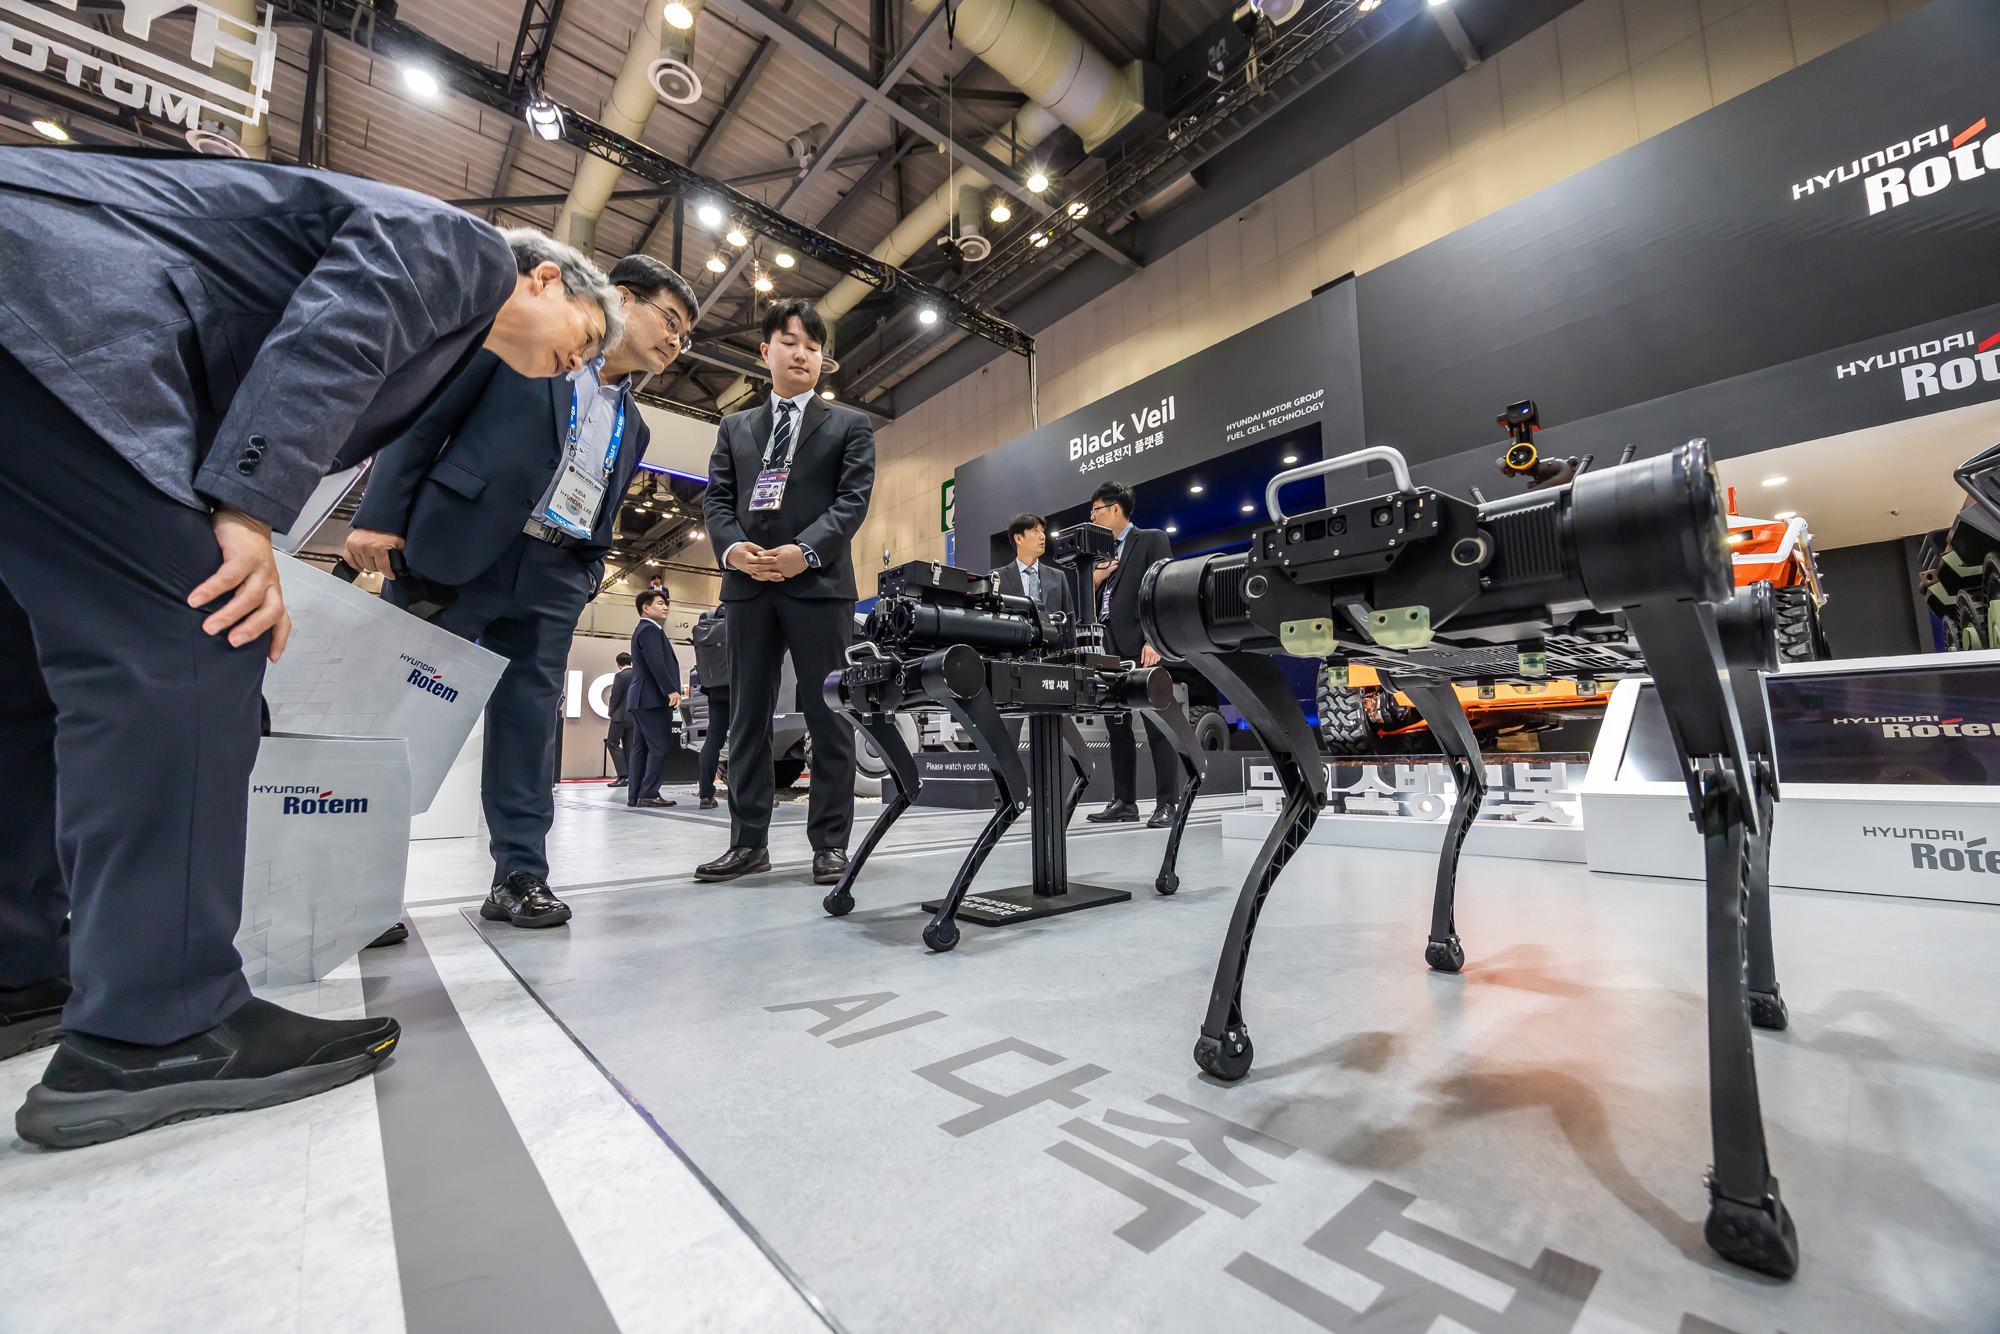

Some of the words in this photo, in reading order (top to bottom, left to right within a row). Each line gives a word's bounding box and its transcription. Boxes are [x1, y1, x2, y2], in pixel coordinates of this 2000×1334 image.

[1792, 124, 1950, 200] HYUNDAI
[1836, 330, 1975, 379] HYUNDAI
[1226, 413, 1261, 432] HYUNDAI
[1262, 401, 1292, 418] MOTOR
[1293, 389, 1324, 407] GROUP
[1226, 430, 1245, 442] FUEL
[1247, 423, 1266, 435] CELL
[1268, 400, 1325, 427] TECHNOLOGY
[1069, 420, 1125, 462] Black
[1131, 395, 1176, 434] Veil
[1079, 443, 1132, 475] 수소연료전지
[1134, 430, 1164, 454] 플랫폼
[400, 653, 437, 675] HYUNDAI
[406, 668, 459, 703] Rotem
[1833, 715, 1940, 725] HYUNDAI
[1882, 717, 2000, 738] Rote
[926, 761, 944, 770] Please
[944, 762, 962, 770] watch
[962, 763, 977, 772] your
[253, 785, 320, 794] HYUNDAI
[283, 790, 368, 815] Rotem
[1863, 826, 1965, 841] HYUNDAI
[763, 991, 949, 1049] AI
